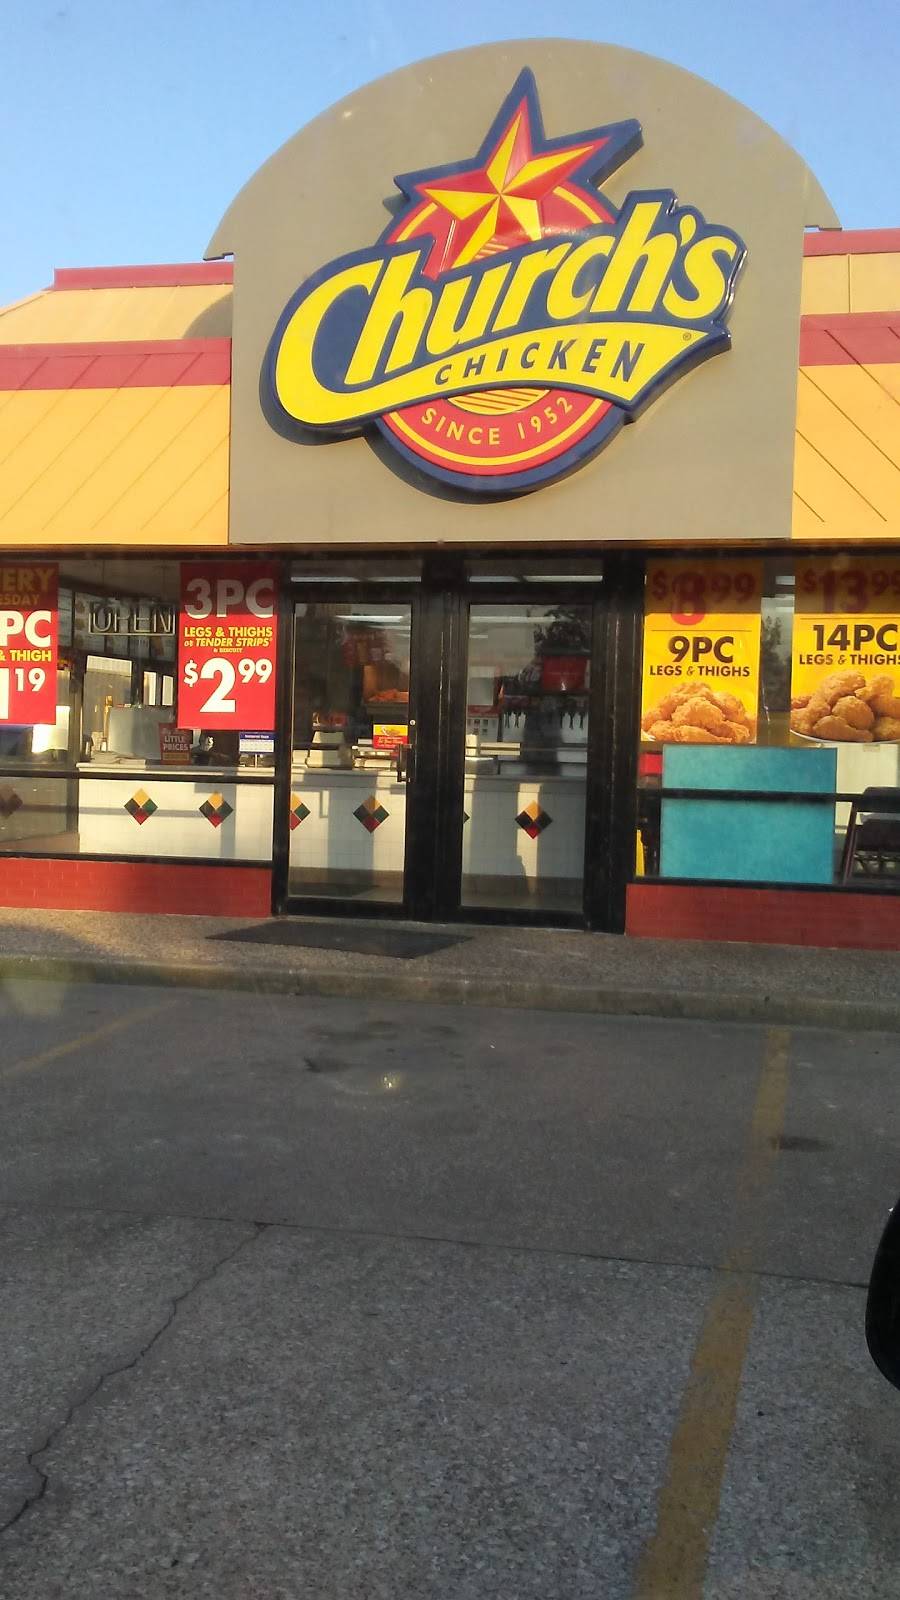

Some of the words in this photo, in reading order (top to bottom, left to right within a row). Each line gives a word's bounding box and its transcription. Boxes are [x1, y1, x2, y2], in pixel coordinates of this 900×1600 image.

[276, 200, 737, 423] Church's
[434, 338, 645, 383] CHICKEN
[421, 407, 499, 445] SINCE
[517, 397, 573, 440] 1952
[0, 568, 54, 592] ERY
[184, 578, 274, 619] 3PC
[92, 604, 172, 632] OPEN
[184, 627, 212, 637] LEGS
[215, 626, 225, 637] &
[228, 627, 273, 637] THIGHS
[196, 637, 233, 647] TENDER
[668, 636, 735, 664] 9PC
[813, 623, 898, 651] 14PC
[10, 650, 52, 661] THIGH
[799, 654, 833, 666] LEGS
[837, 654, 847, 665] &
[850, 654, 900, 666] THIGH
[649, 665, 682, 676] LEGS
[686, 666, 696, 676] &
[698, 665, 751, 677] THIGHS
